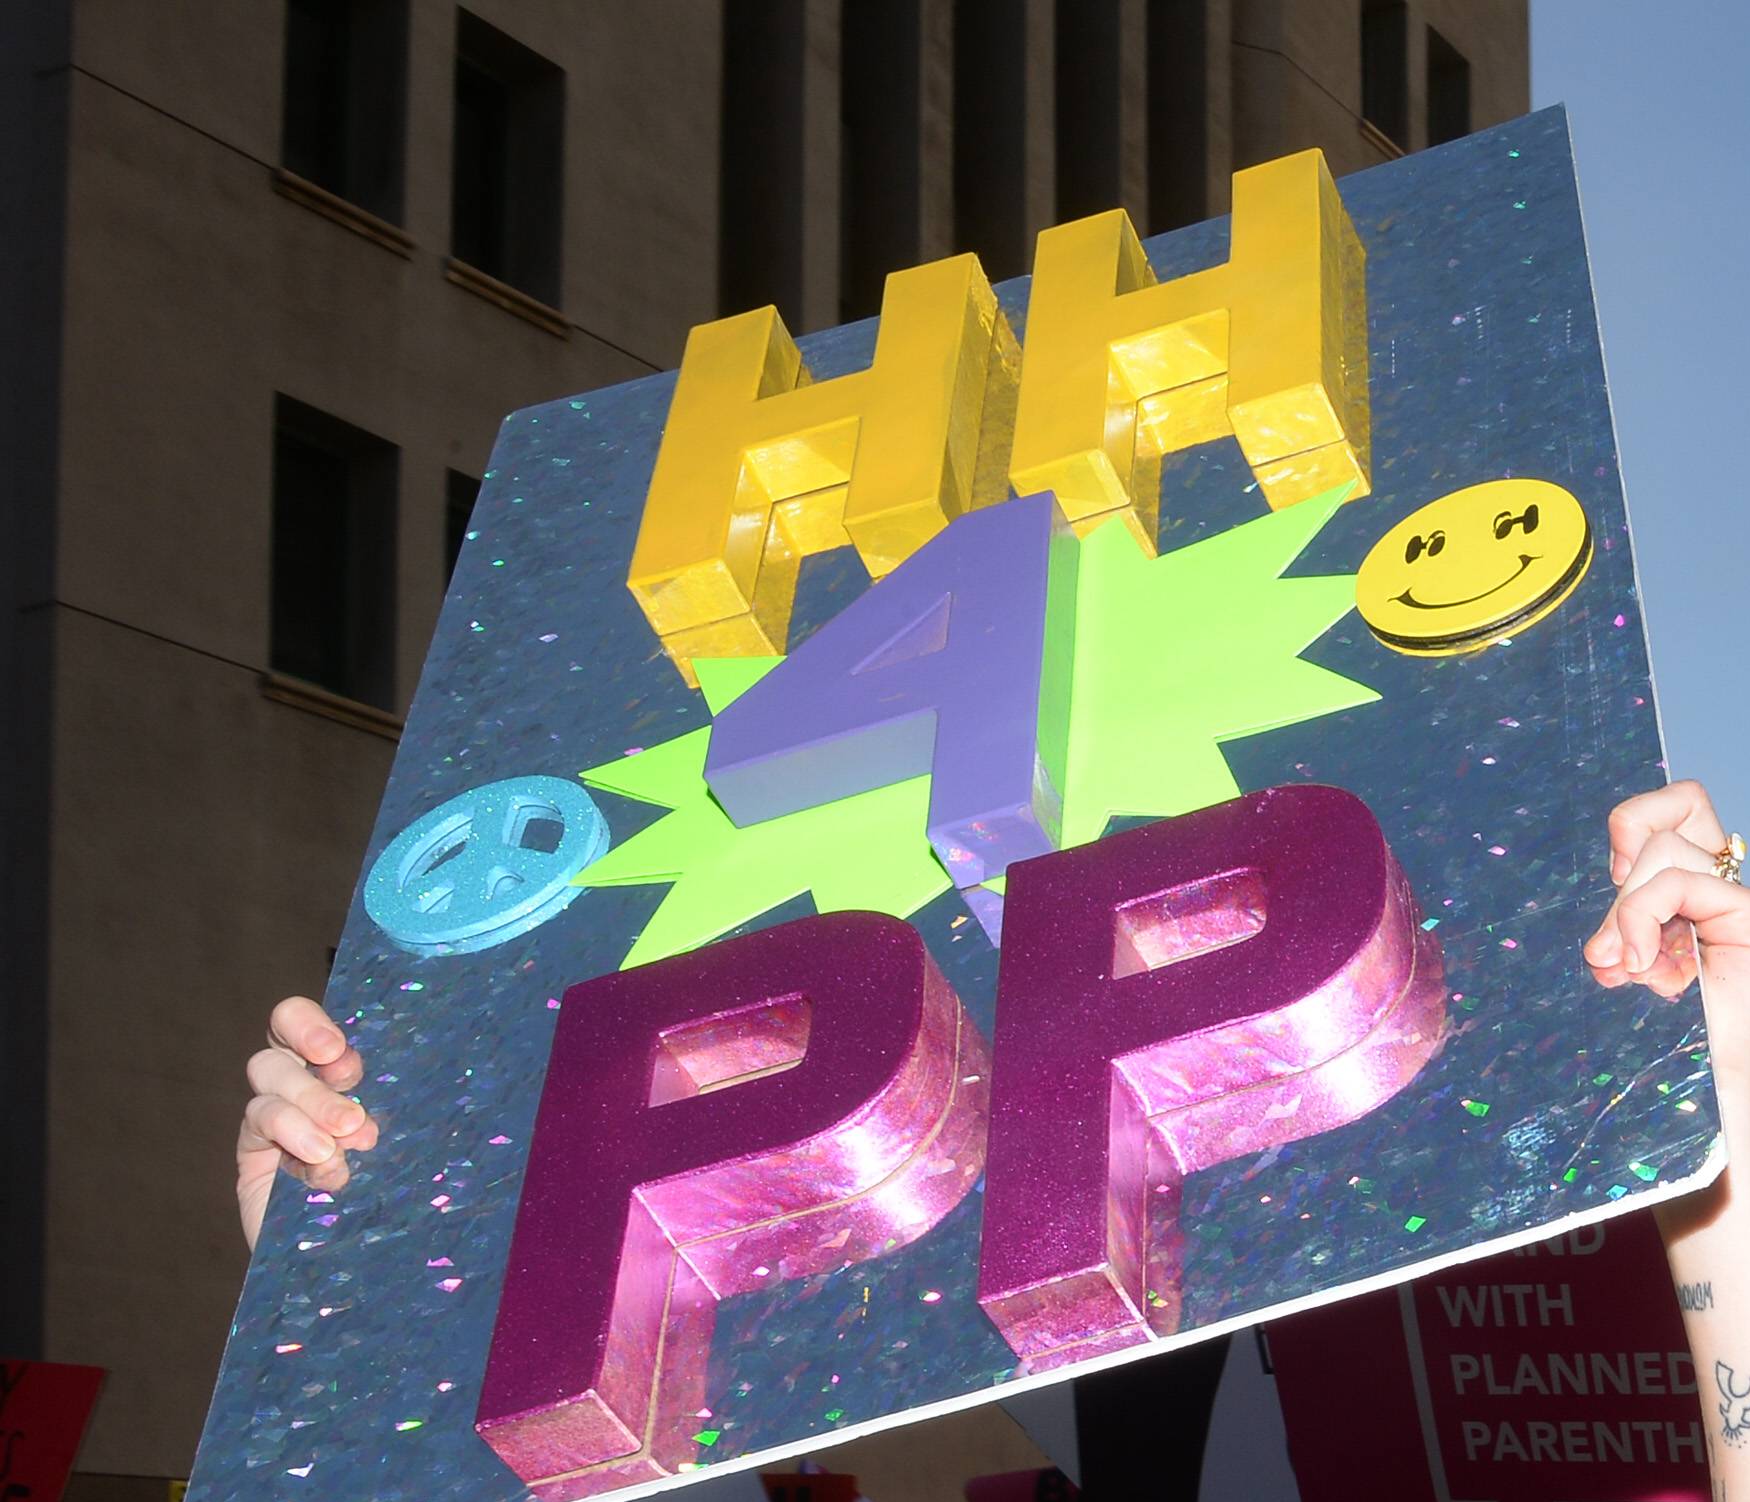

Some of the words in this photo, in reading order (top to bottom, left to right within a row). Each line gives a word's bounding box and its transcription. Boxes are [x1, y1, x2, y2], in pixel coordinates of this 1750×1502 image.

[626, 146, 1370, 690] HH
[1437, 1284, 1575, 1328] WITH
[1449, 1352, 1697, 1396] PLANNED
